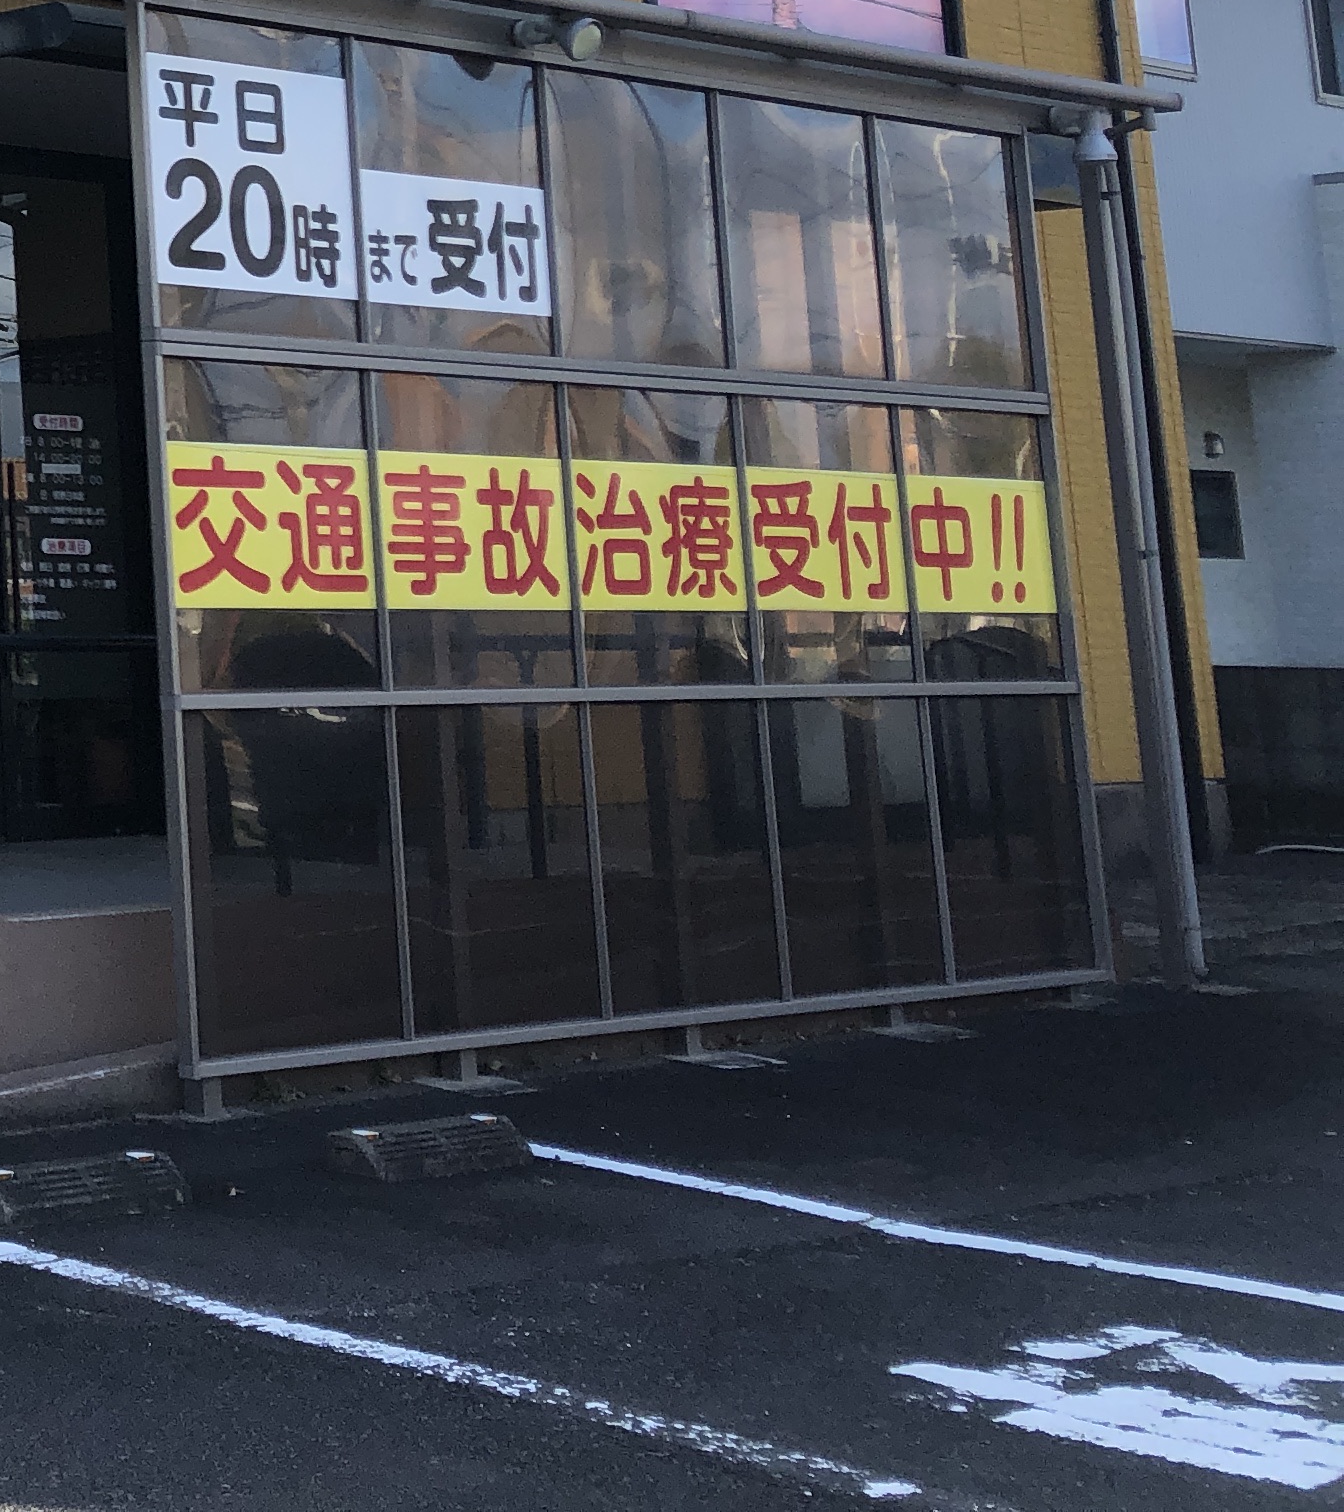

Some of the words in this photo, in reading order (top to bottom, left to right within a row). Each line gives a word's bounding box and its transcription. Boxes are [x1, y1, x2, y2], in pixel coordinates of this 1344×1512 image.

[158, 69, 285, 155] 平日
[172, 455, 1025, 604] 交通事故治療受付中!!
